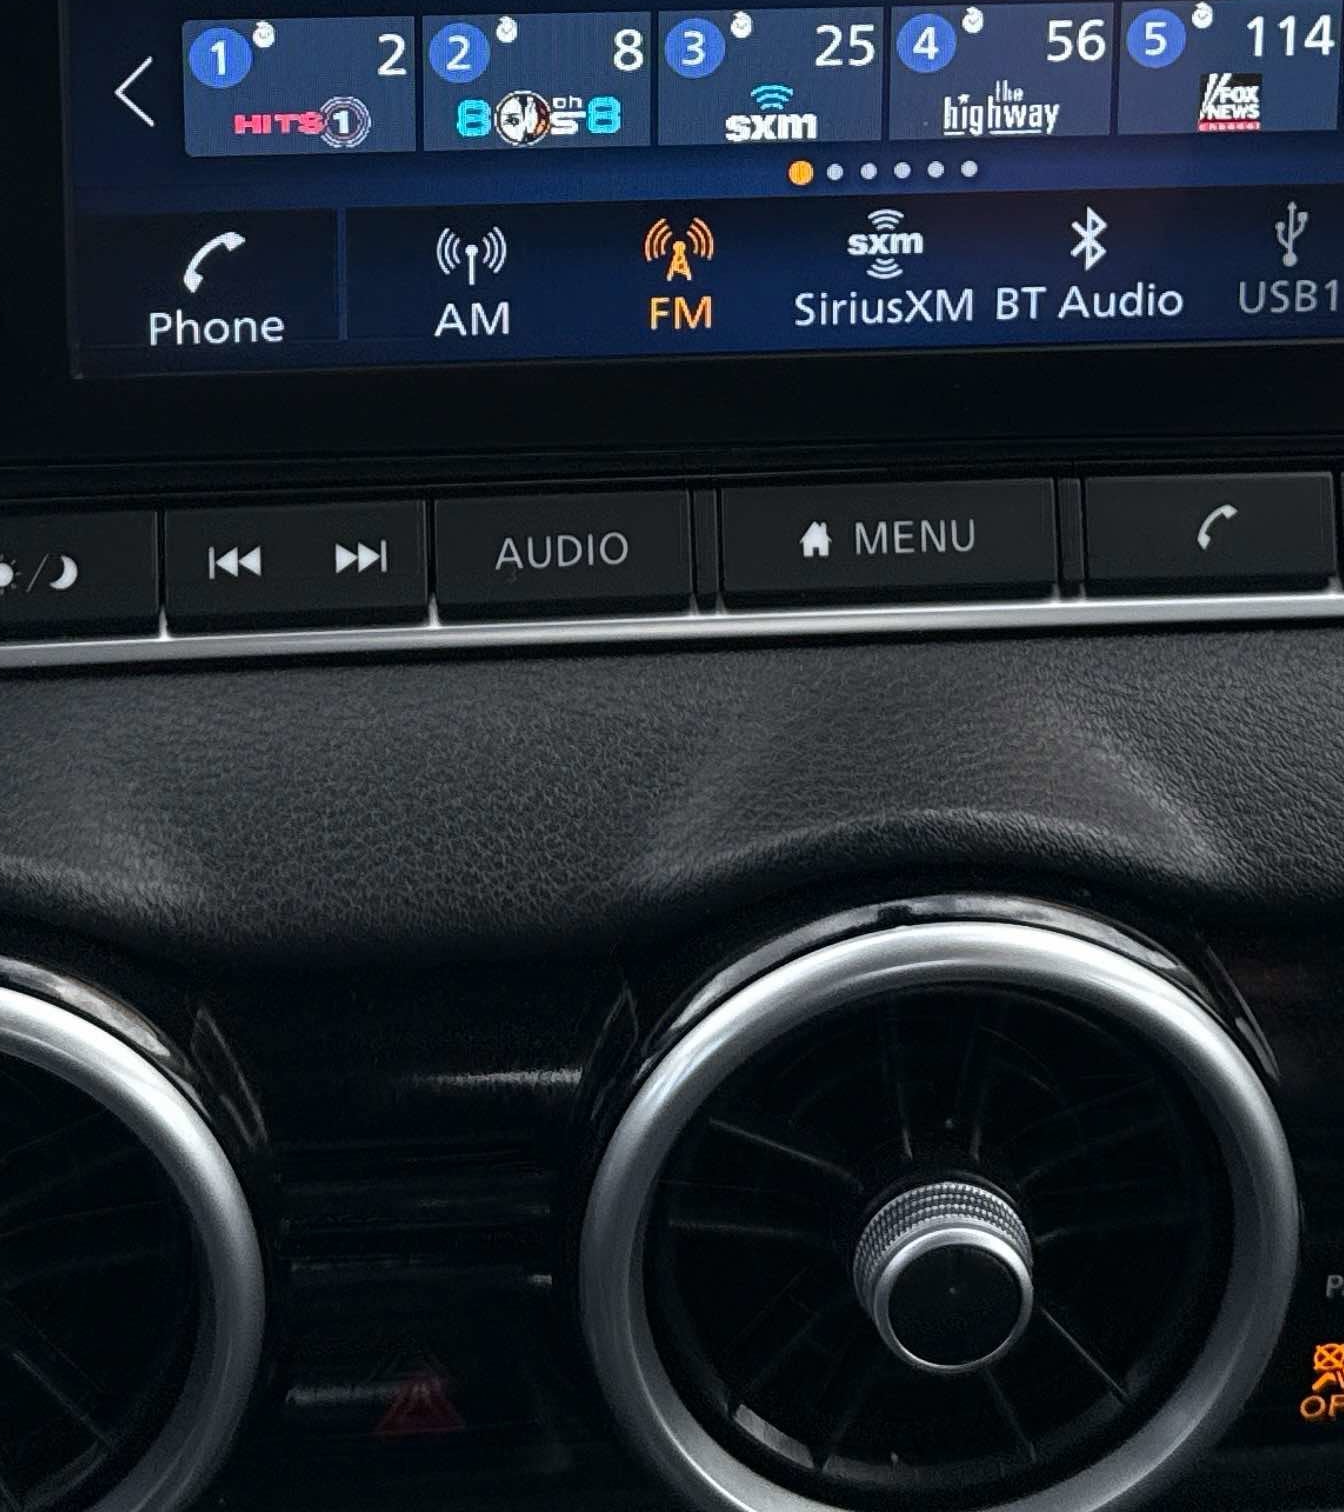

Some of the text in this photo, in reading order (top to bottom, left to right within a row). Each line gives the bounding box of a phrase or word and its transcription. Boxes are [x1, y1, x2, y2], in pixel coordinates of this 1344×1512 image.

[445, 37, 472, 71] 2
[611, 29, 644, 72] 8
[682, 30, 706, 66] 3
[813, 24, 875, 68] 25
[911, 26, 940, 61] 4
[1045, 20, 1106, 62] 56
[1144, 23, 1168, 57] 5
[1245, 14, 1336, 58] 114
[207, 41, 229, 77] 1
[376, 34, 407, 77] 2
[233, 111, 327, 136] HITS
[724, 112, 818, 142] sxm
[943, 93, 1060, 135] highway
[847, 232, 924, 256] sxm
[650, 296, 713, 330] FM
[794, 289, 974, 327] SiriusXM
[996, 282, 1184, 320] BT Audio
[1239, 280, 1340, 314] USB1
[148, 311, 285, 349] Phone
[434, 302, 511, 338] AM
[495, 532, 630, 571] AUDIO
[855, 519, 977, 555] MENU
